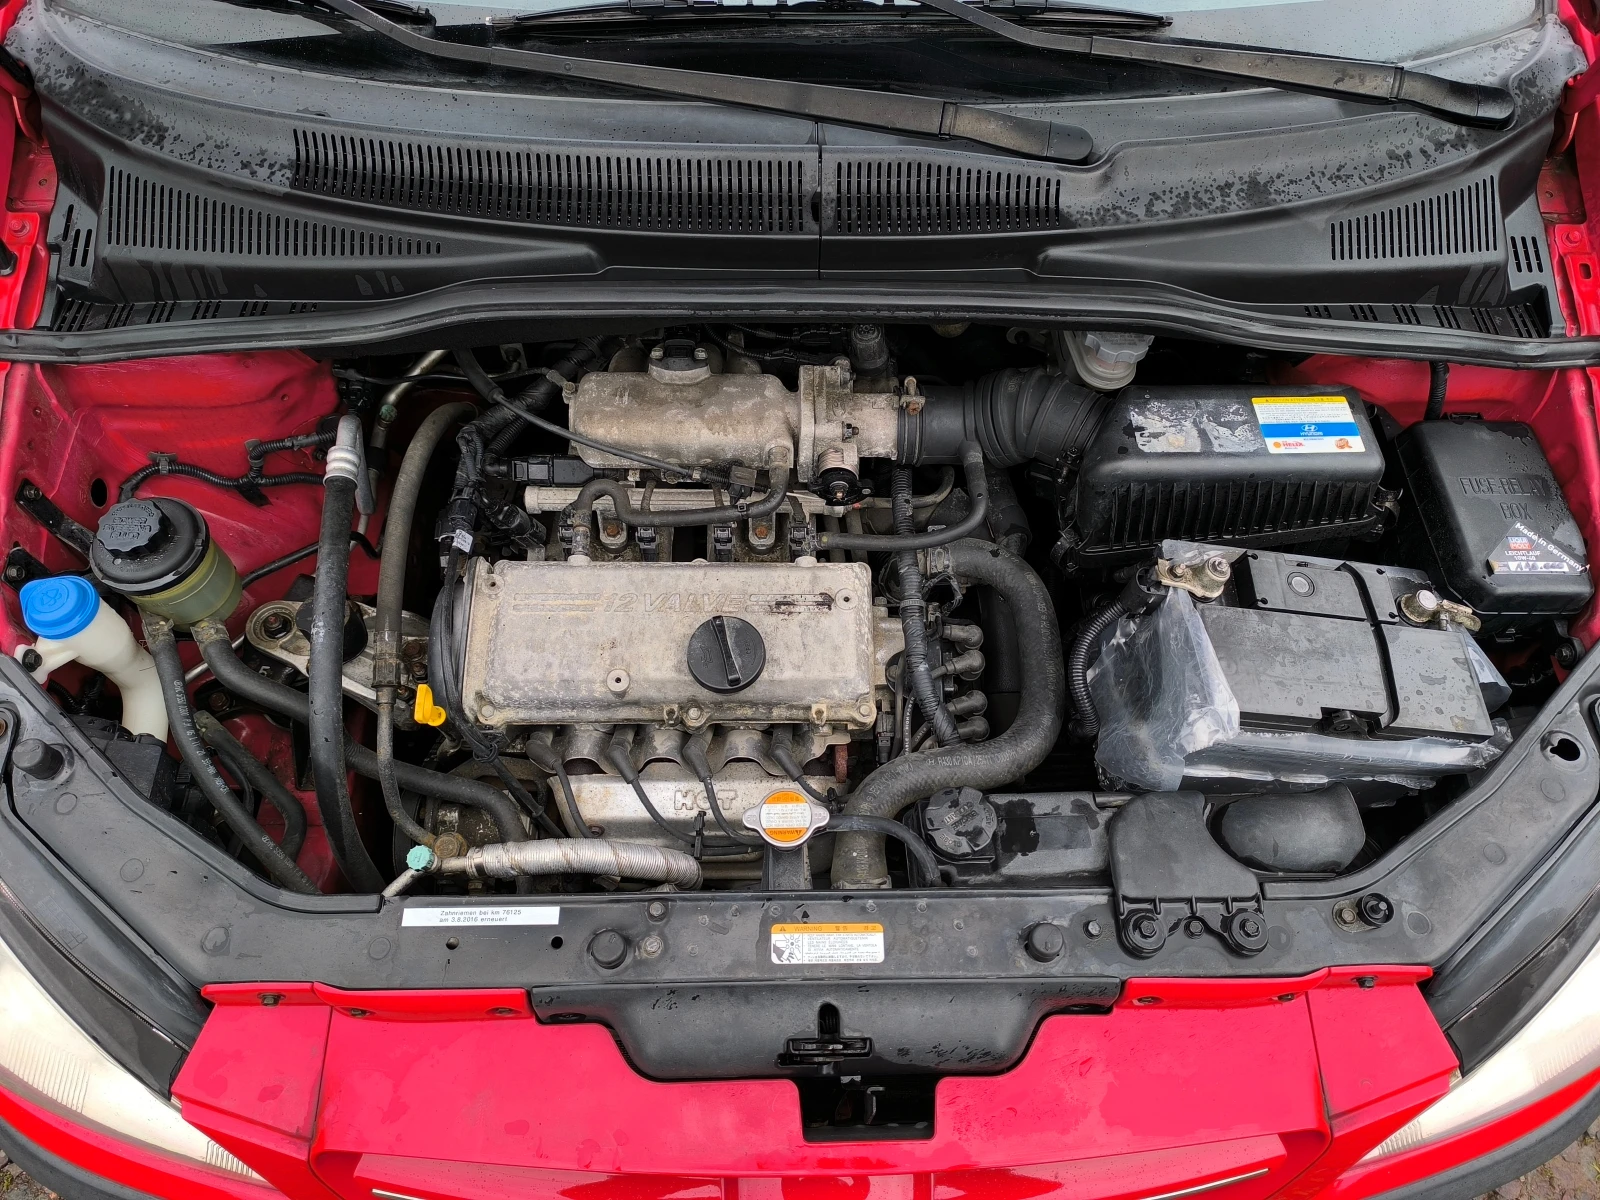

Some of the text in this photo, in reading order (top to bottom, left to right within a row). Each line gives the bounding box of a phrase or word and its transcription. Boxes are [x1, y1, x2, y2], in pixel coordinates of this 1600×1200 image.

[1499, 502, 1533, 520] BOX
[1509, 542, 1531, 550] MOLY
[1514, 522, 1538, 541] Made
[1537, 538, 1547, 547] in
[1547, 543, 1585, 572] Germany
[603, 592, 746, 613] 12 VALVE
